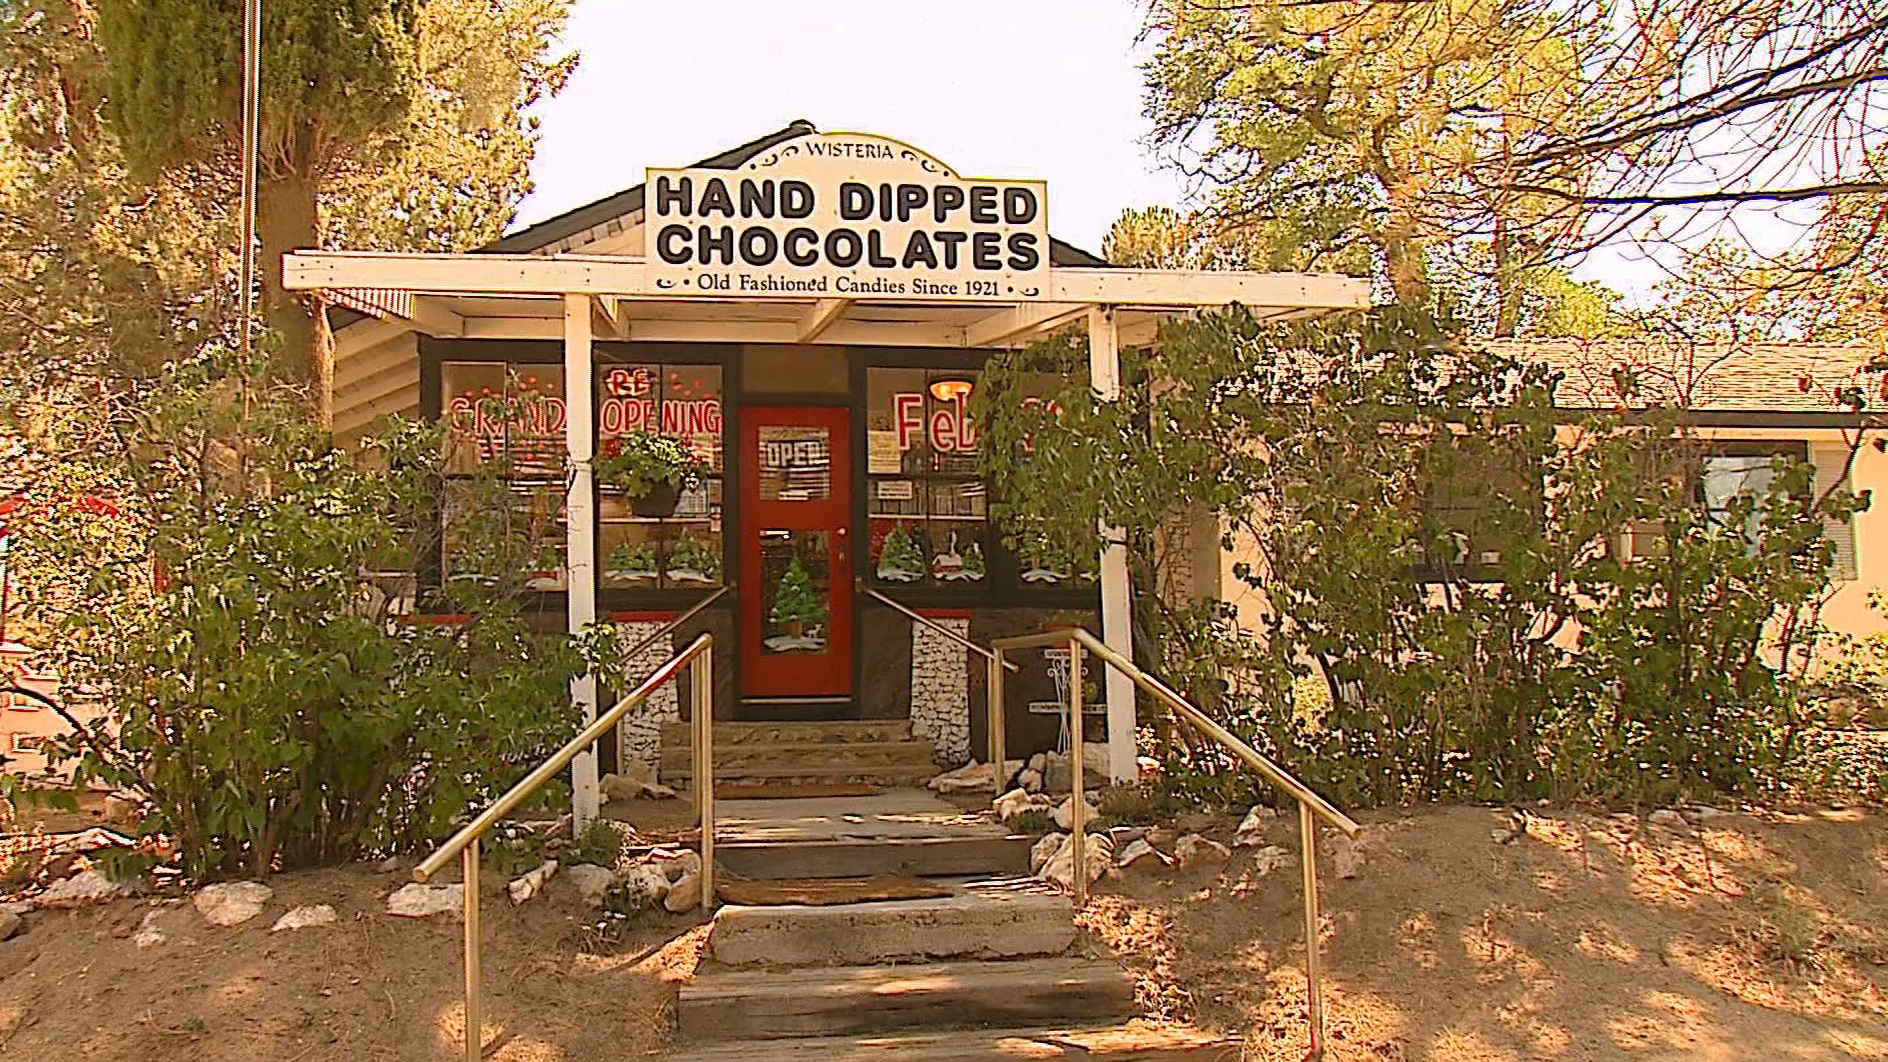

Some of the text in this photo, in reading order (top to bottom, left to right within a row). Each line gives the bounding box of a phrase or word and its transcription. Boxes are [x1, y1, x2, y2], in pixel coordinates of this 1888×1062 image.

[806, 142, 894, 159] WISTERIA
[656, 175, 1038, 225] HAND DIPPED
[656, 223, 1040, 271] CHOCOLATES
[697, 273, 731, 290] Old
[835, 275, 905, 294] Candies
[912, 277, 958, 296] Since
[965, 280, 1000, 296] 1921
[606, 368, 651, 396] RE
[450, 397, 723, 437] GRAND OPENING
